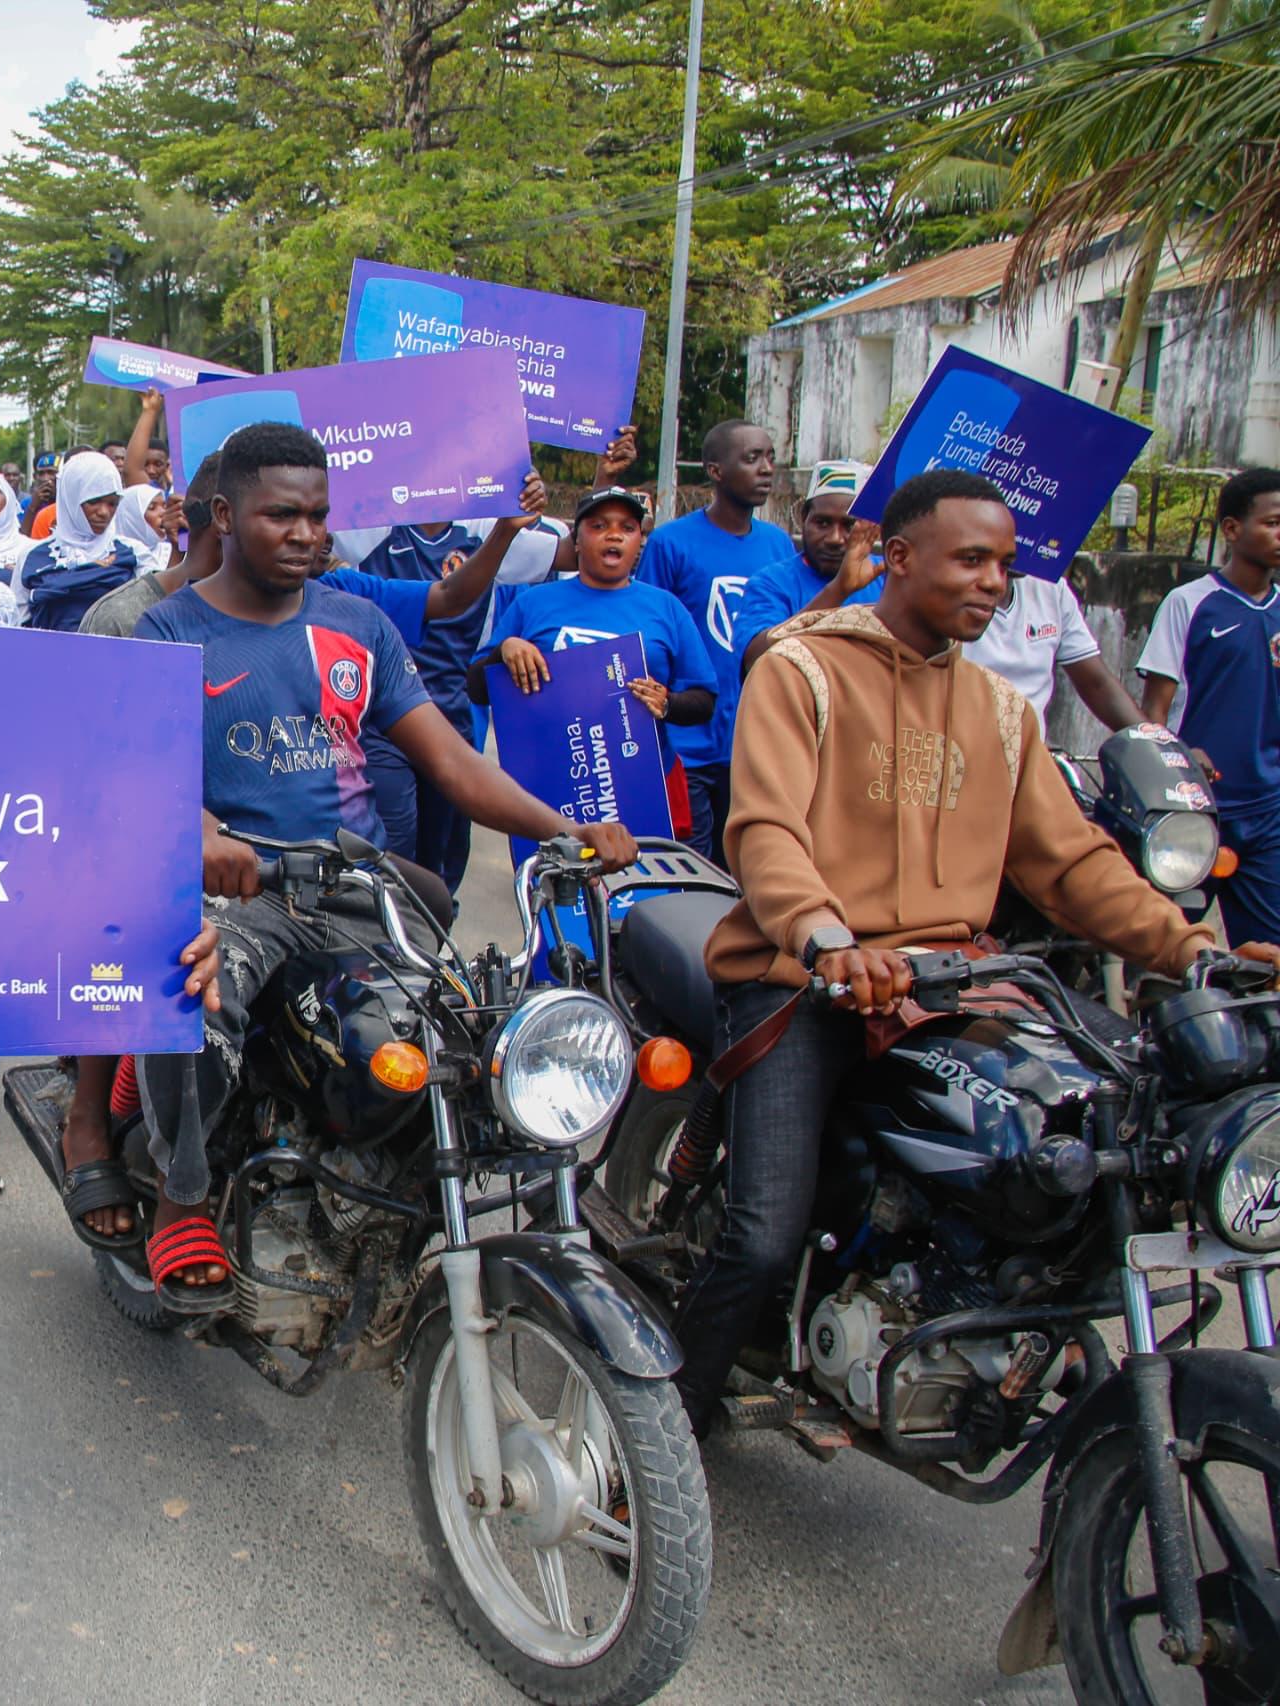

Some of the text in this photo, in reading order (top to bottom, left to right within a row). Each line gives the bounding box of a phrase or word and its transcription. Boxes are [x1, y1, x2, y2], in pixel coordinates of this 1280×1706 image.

[394, 331, 463, 355] Mmet
[398, 310, 566, 360] Wafanyabiashara
[312, 420, 413, 446] Mkubwa
[572, 424, 603, 436] CROWN
[949, 411, 1026, 458] Bodaboda
[937, 434, 1021, 481] Tumefurahi
[1020, 466, 1059, 500] Sana,
[411, 485, 457, 498] Stanbic Bank
[467, 484, 504, 495] CROWN
[985, 477, 1042, 516] ubwa
[612, 653, 625, 687] CROWN
[227, 713, 348, 762] QATAR
[567, 717, 590, 780] Sana,
[900, 727, 935, 750] THE
[589, 724, 620, 824] Mkubwa
[879, 763, 930, 787] FCE
[11, 978, 48, 994] Bank
[70, 985, 143, 1002] CROWN
[92, 1003, 121, 1012] MEDIA
[919, 1050, 1019, 1113] BOXER
